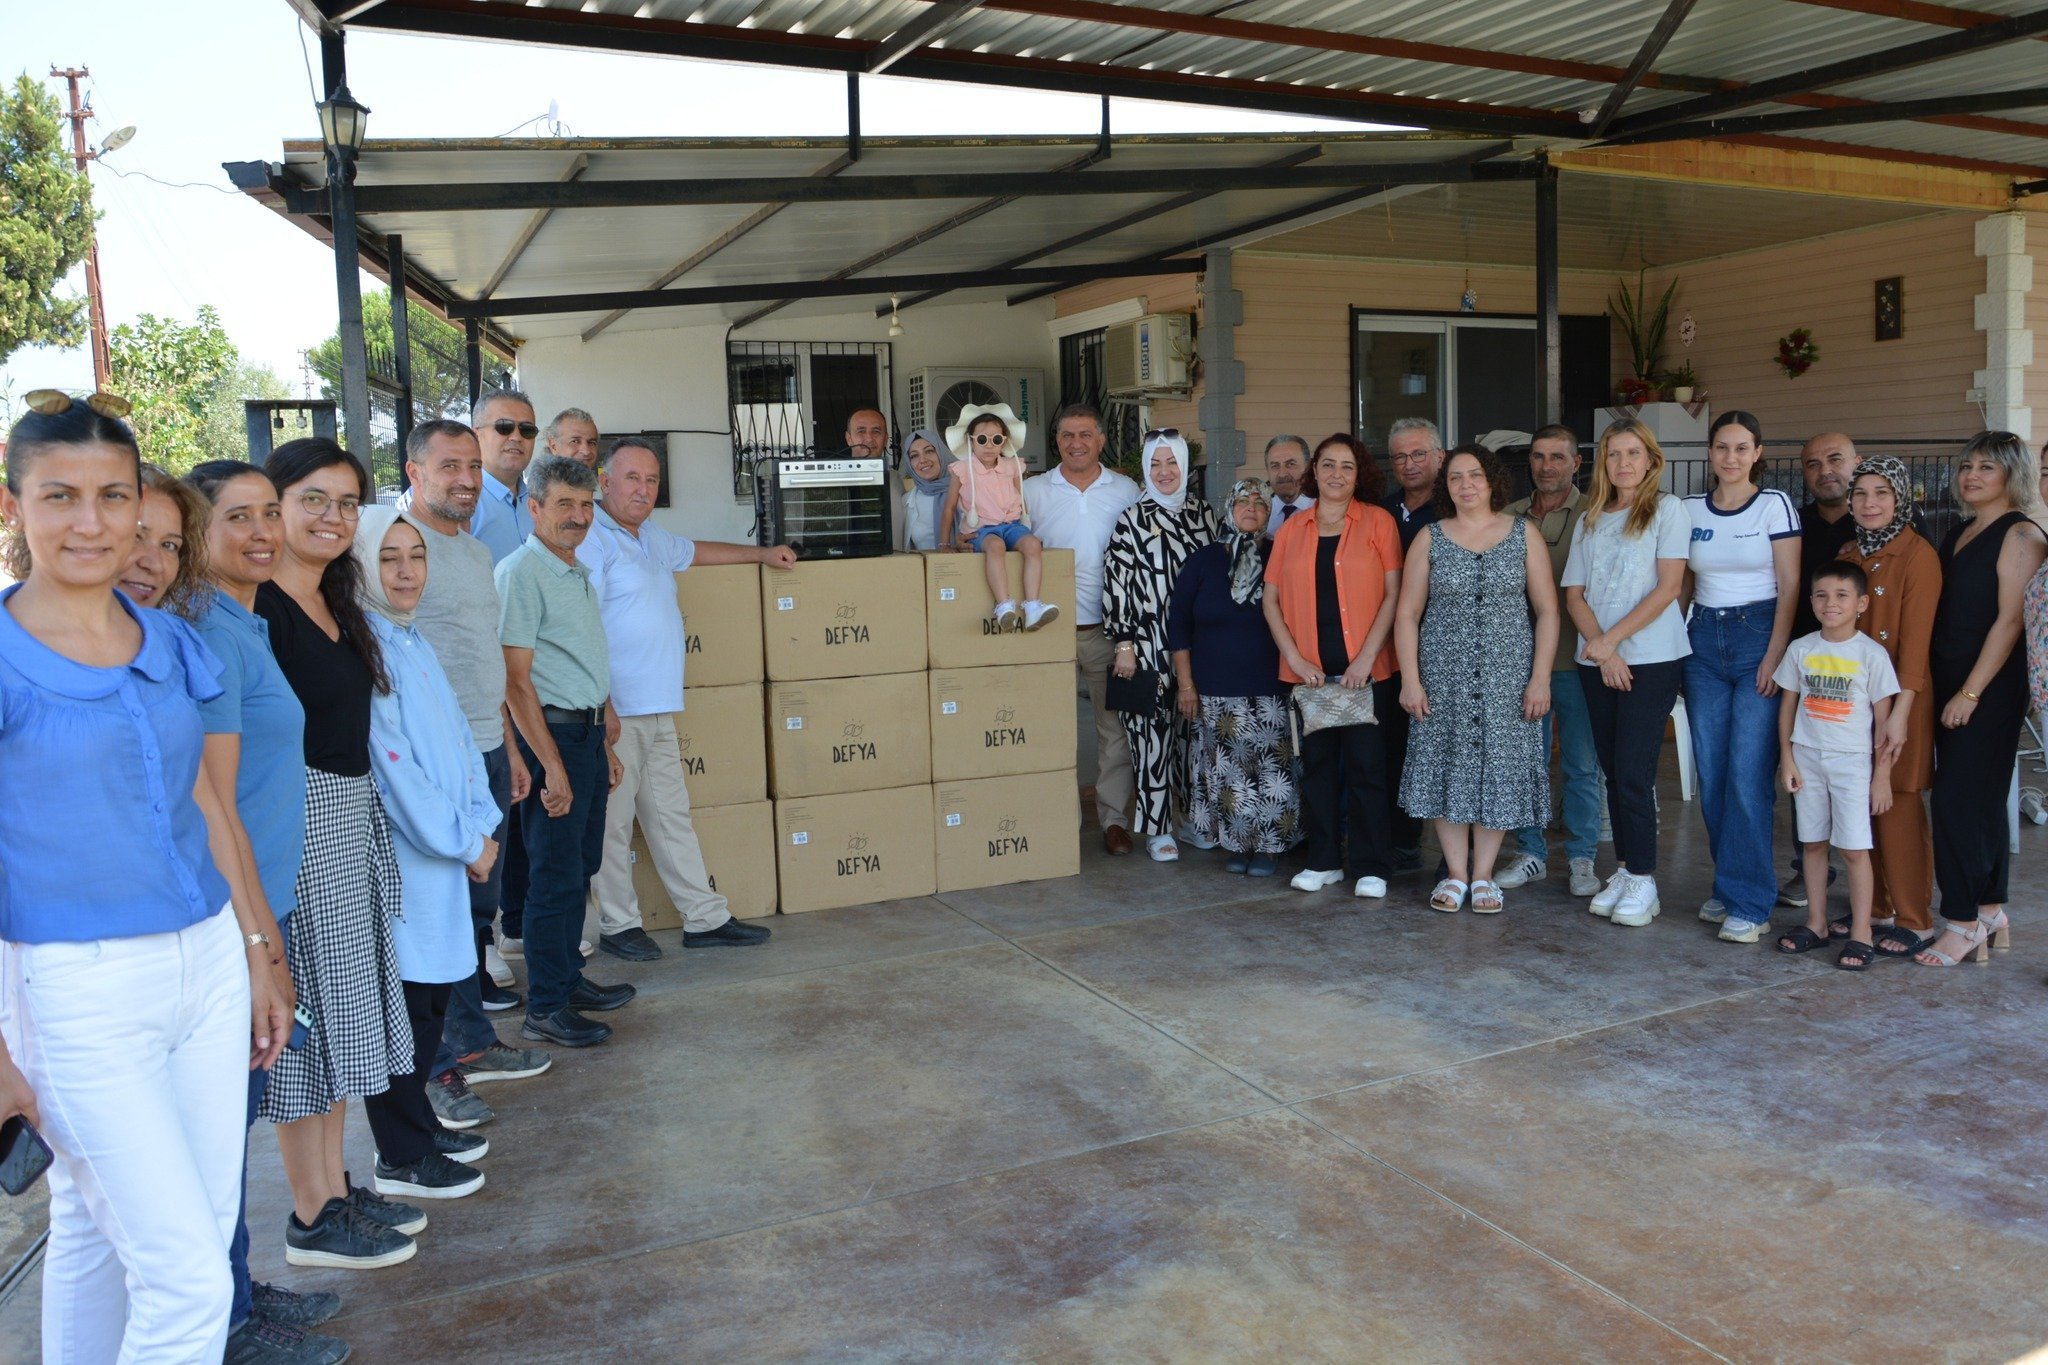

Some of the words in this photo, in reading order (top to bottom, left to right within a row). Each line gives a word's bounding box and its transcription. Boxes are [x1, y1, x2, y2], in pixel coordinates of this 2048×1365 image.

[1019, 378, 1029, 417] baymak
[825, 625, 870, 645] DEFYA
[983, 616, 1024, 636] DEA
[1805, 674, 1821, 688] NO
[1823, 675, 1853, 690] WAY
[985, 727, 1026, 747] DEFYA
[832, 742, 877, 763] DEFYA
[988, 836, 1029, 857] DEFYA
[837, 854, 881, 876] DEFYA
